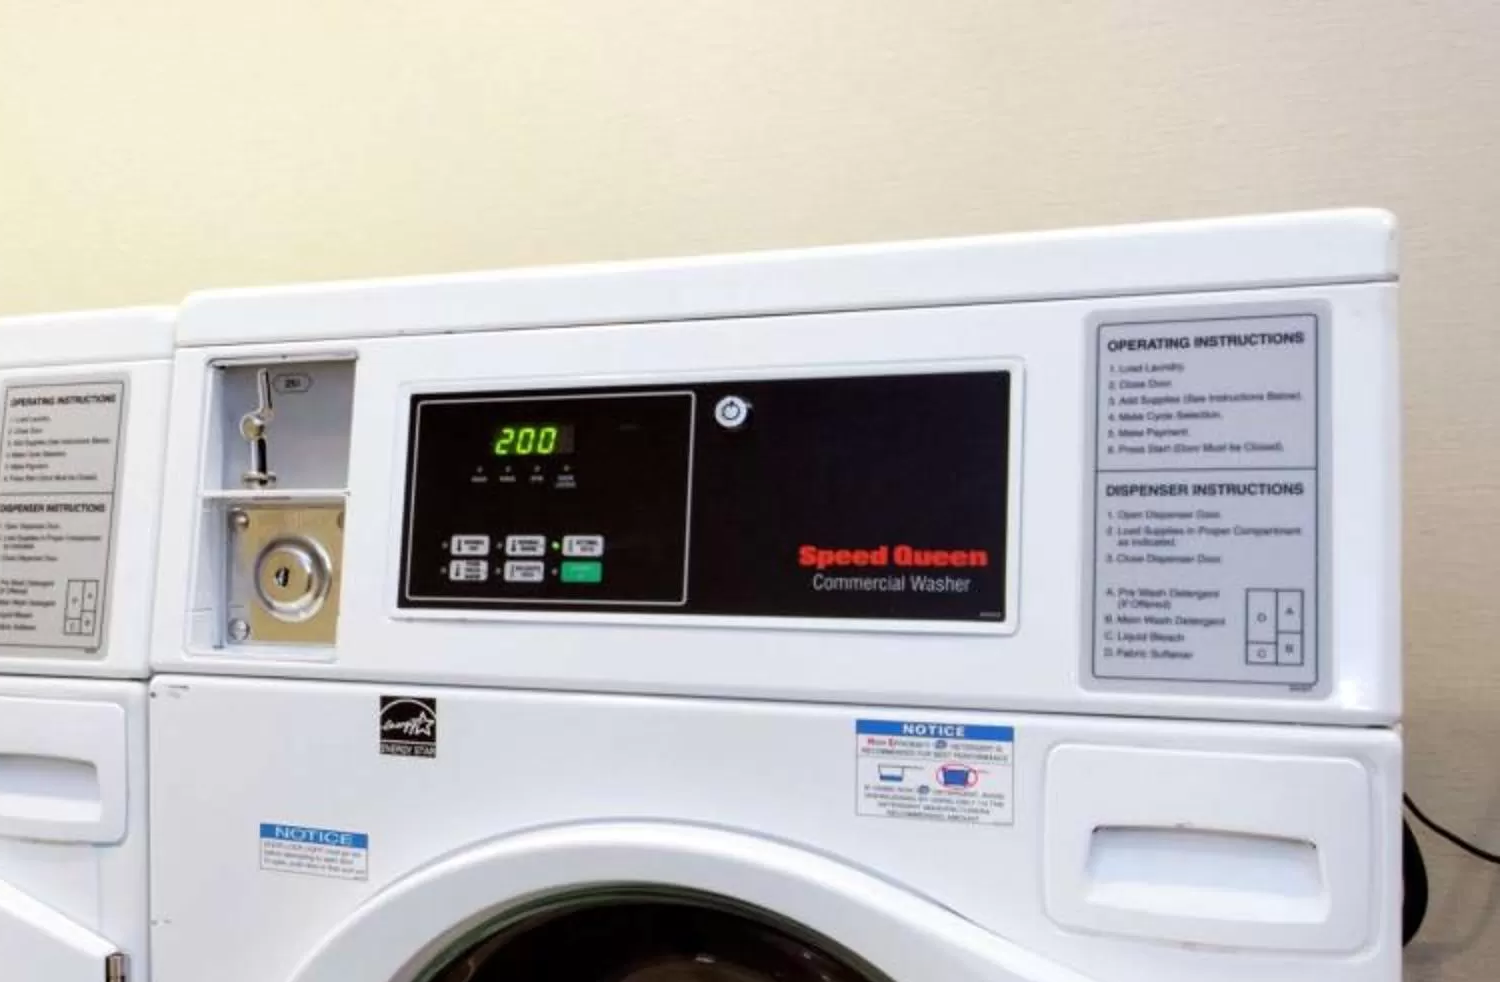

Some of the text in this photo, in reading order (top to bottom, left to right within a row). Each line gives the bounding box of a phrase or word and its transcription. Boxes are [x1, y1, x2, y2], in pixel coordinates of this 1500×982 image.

[1106, 332, 1305, 352] OPERATING INSTRUCTIONS
[494, 426, 558, 456] 200
[1105, 482, 1304, 497] DISPENSER INSTRUCTIONS
[799, 544, 989, 570] Speed Queen
[812, 573, 972, 593] Commercial Washer
[902, 722, 966, 738] NOTICE
[274, 825, 354, 846] NOTICE
